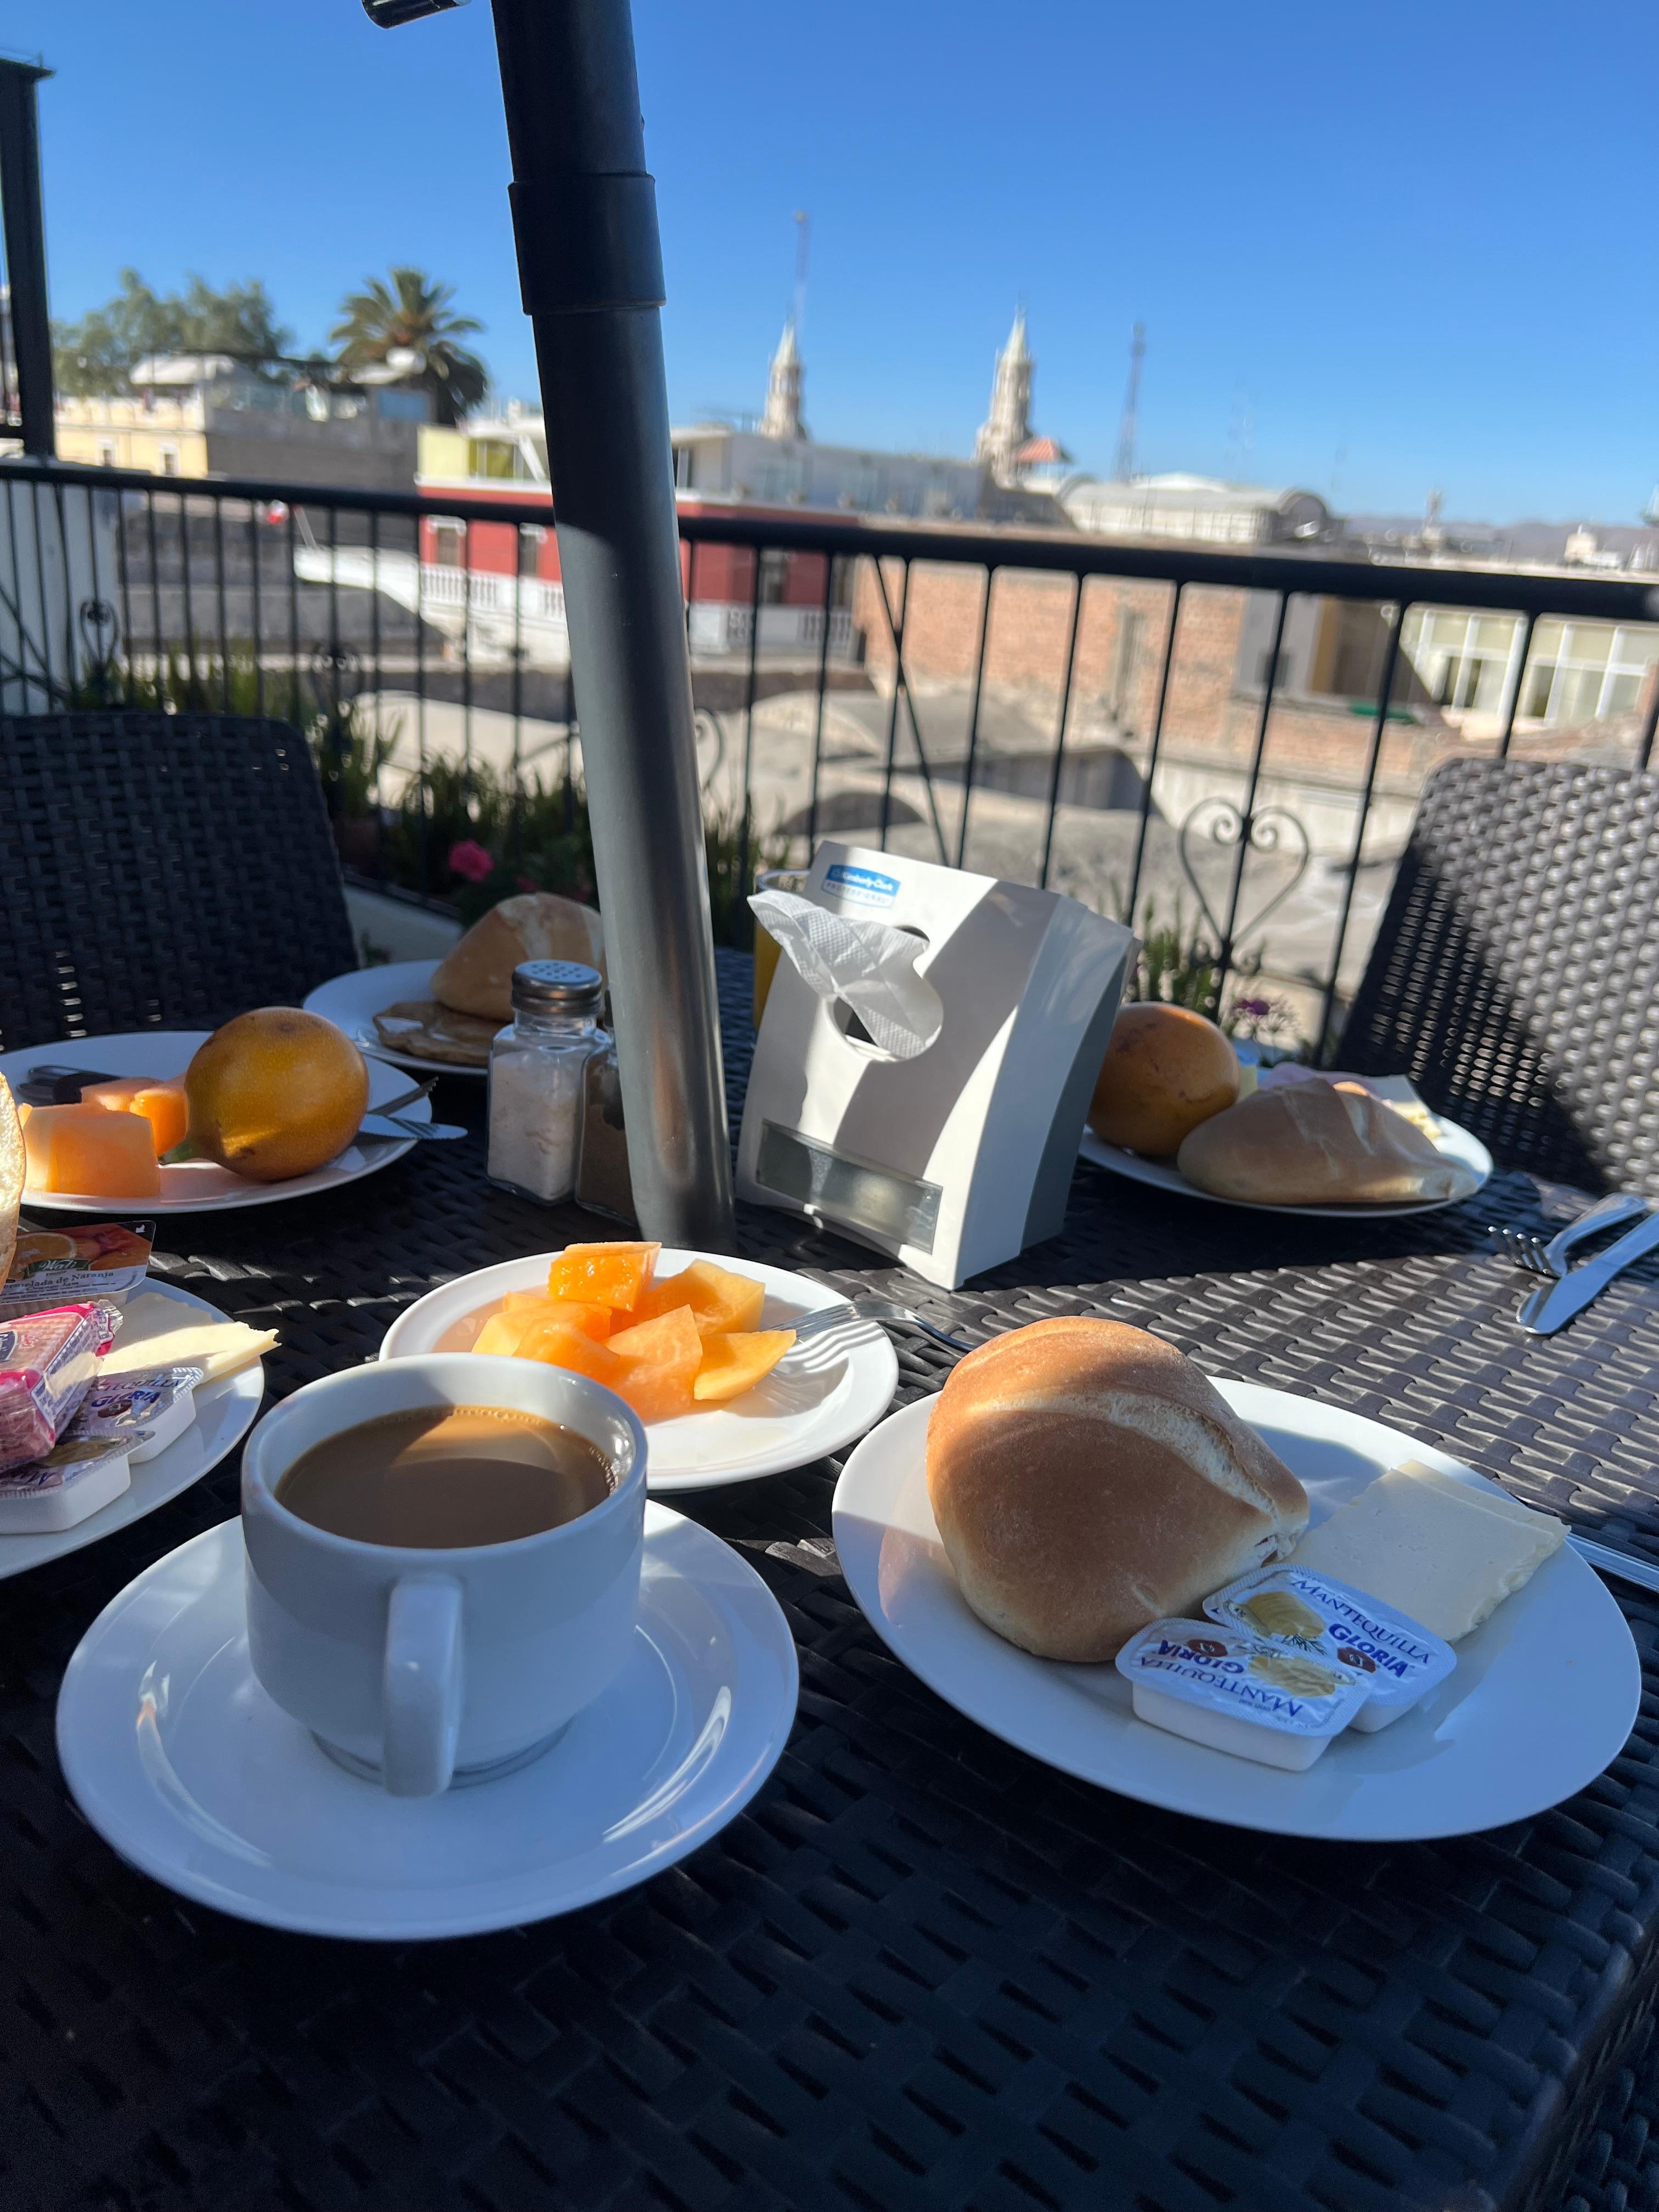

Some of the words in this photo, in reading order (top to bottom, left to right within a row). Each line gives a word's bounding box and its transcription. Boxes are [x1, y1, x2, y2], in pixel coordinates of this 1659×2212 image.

[4, 1279, 53, 1289] ermelada
[57, 1276, 69, 1284] de
[72, 1271, 114, 1282] Naranja
[91, 1390, 161, 1408] GLORIA
[1290, 1579, 1430, 1664] MANTEQUILLA
[1158, 1639, 1244, 1674] GLORIA
[1328, 1623, 1409, 1678] GLORIA
[1141, 1657, 1304, 1717] MANTEQUILLA
